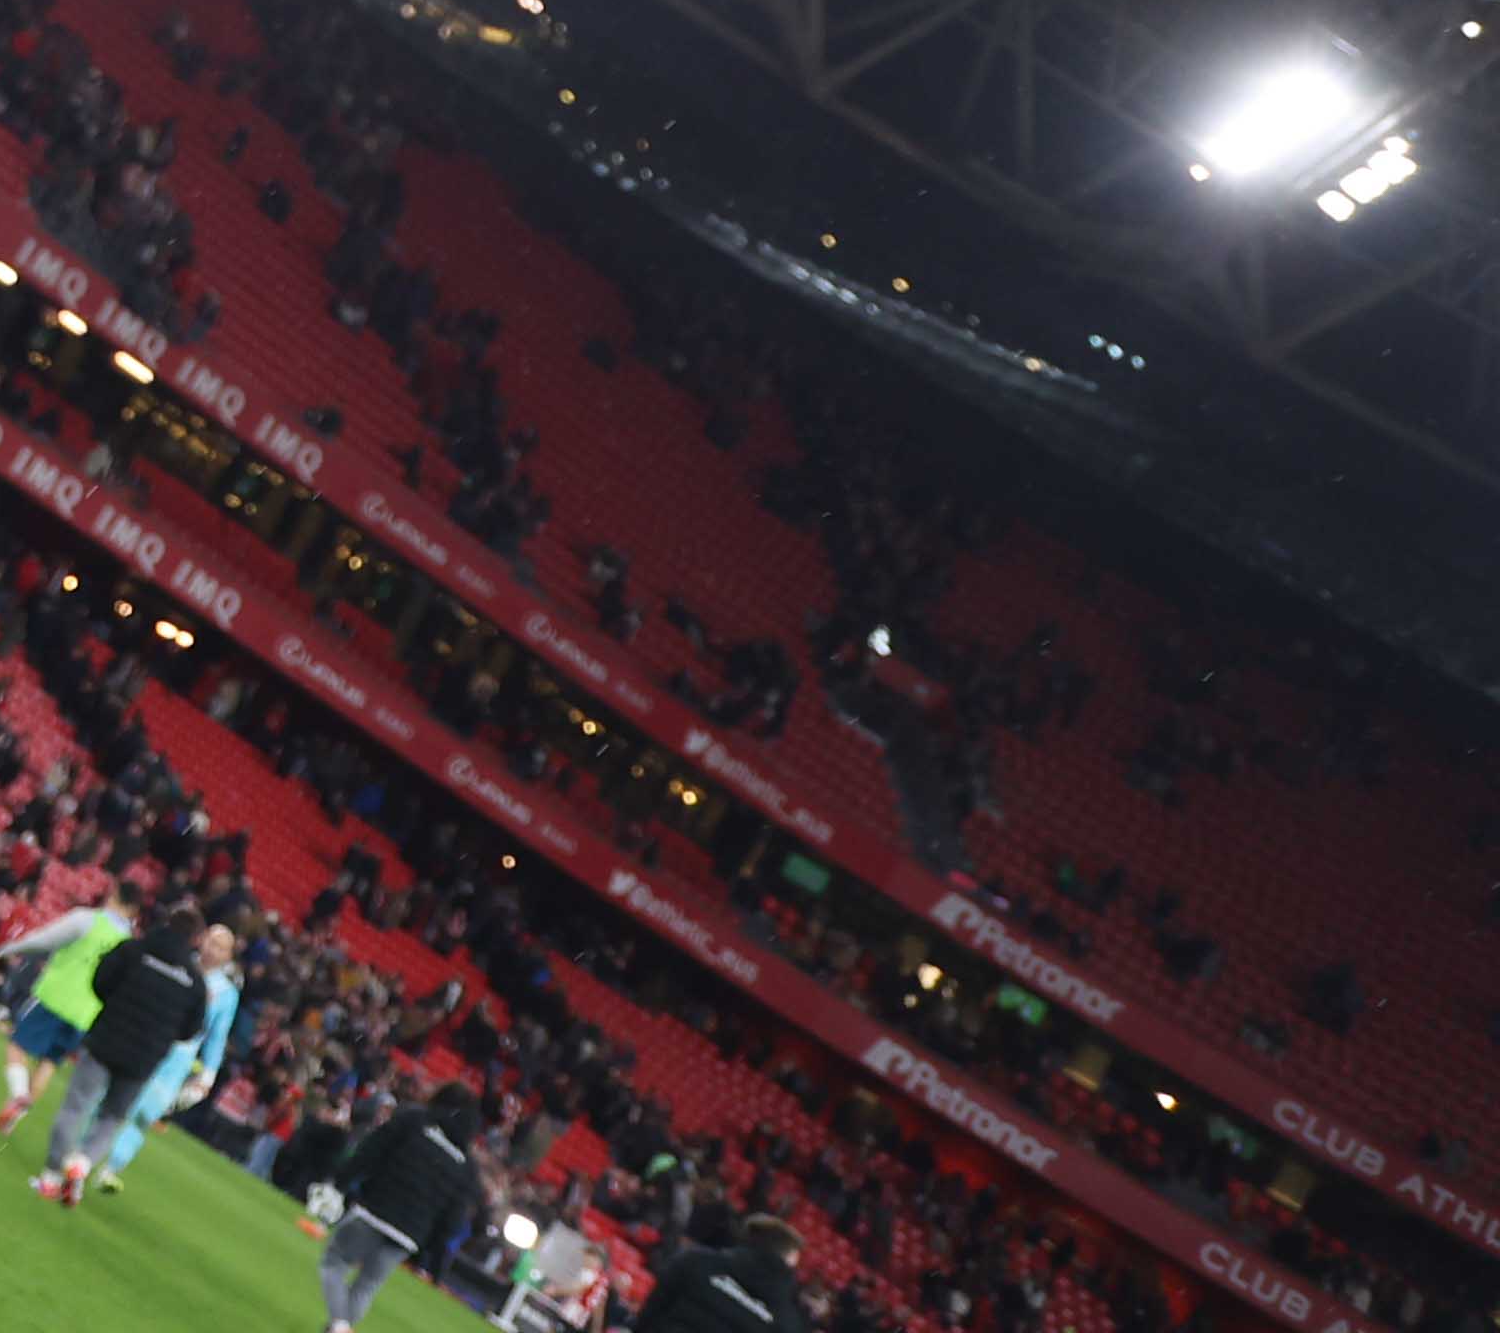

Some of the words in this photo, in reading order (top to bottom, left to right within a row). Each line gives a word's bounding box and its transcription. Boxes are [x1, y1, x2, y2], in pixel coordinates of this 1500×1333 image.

[16, 238, 88, 306] IMQ
[95, 299, 168, 363] IMQ
[176, 359, 246, 425] IMQ
[255, 416, 324, 482] IMQ
[11, 447, 84, 516] IMQ
[95, 506, 166, 574] IMQ
[171, 561, 242, 628] IMQ
[972, 912, 1125, 1021] Petronor
[900, 1054, 1059, 1170] Petronor
[1273, 1100, 1386, 1176] CLUB
[1199, 1242, 1312, 1321] CLUB
